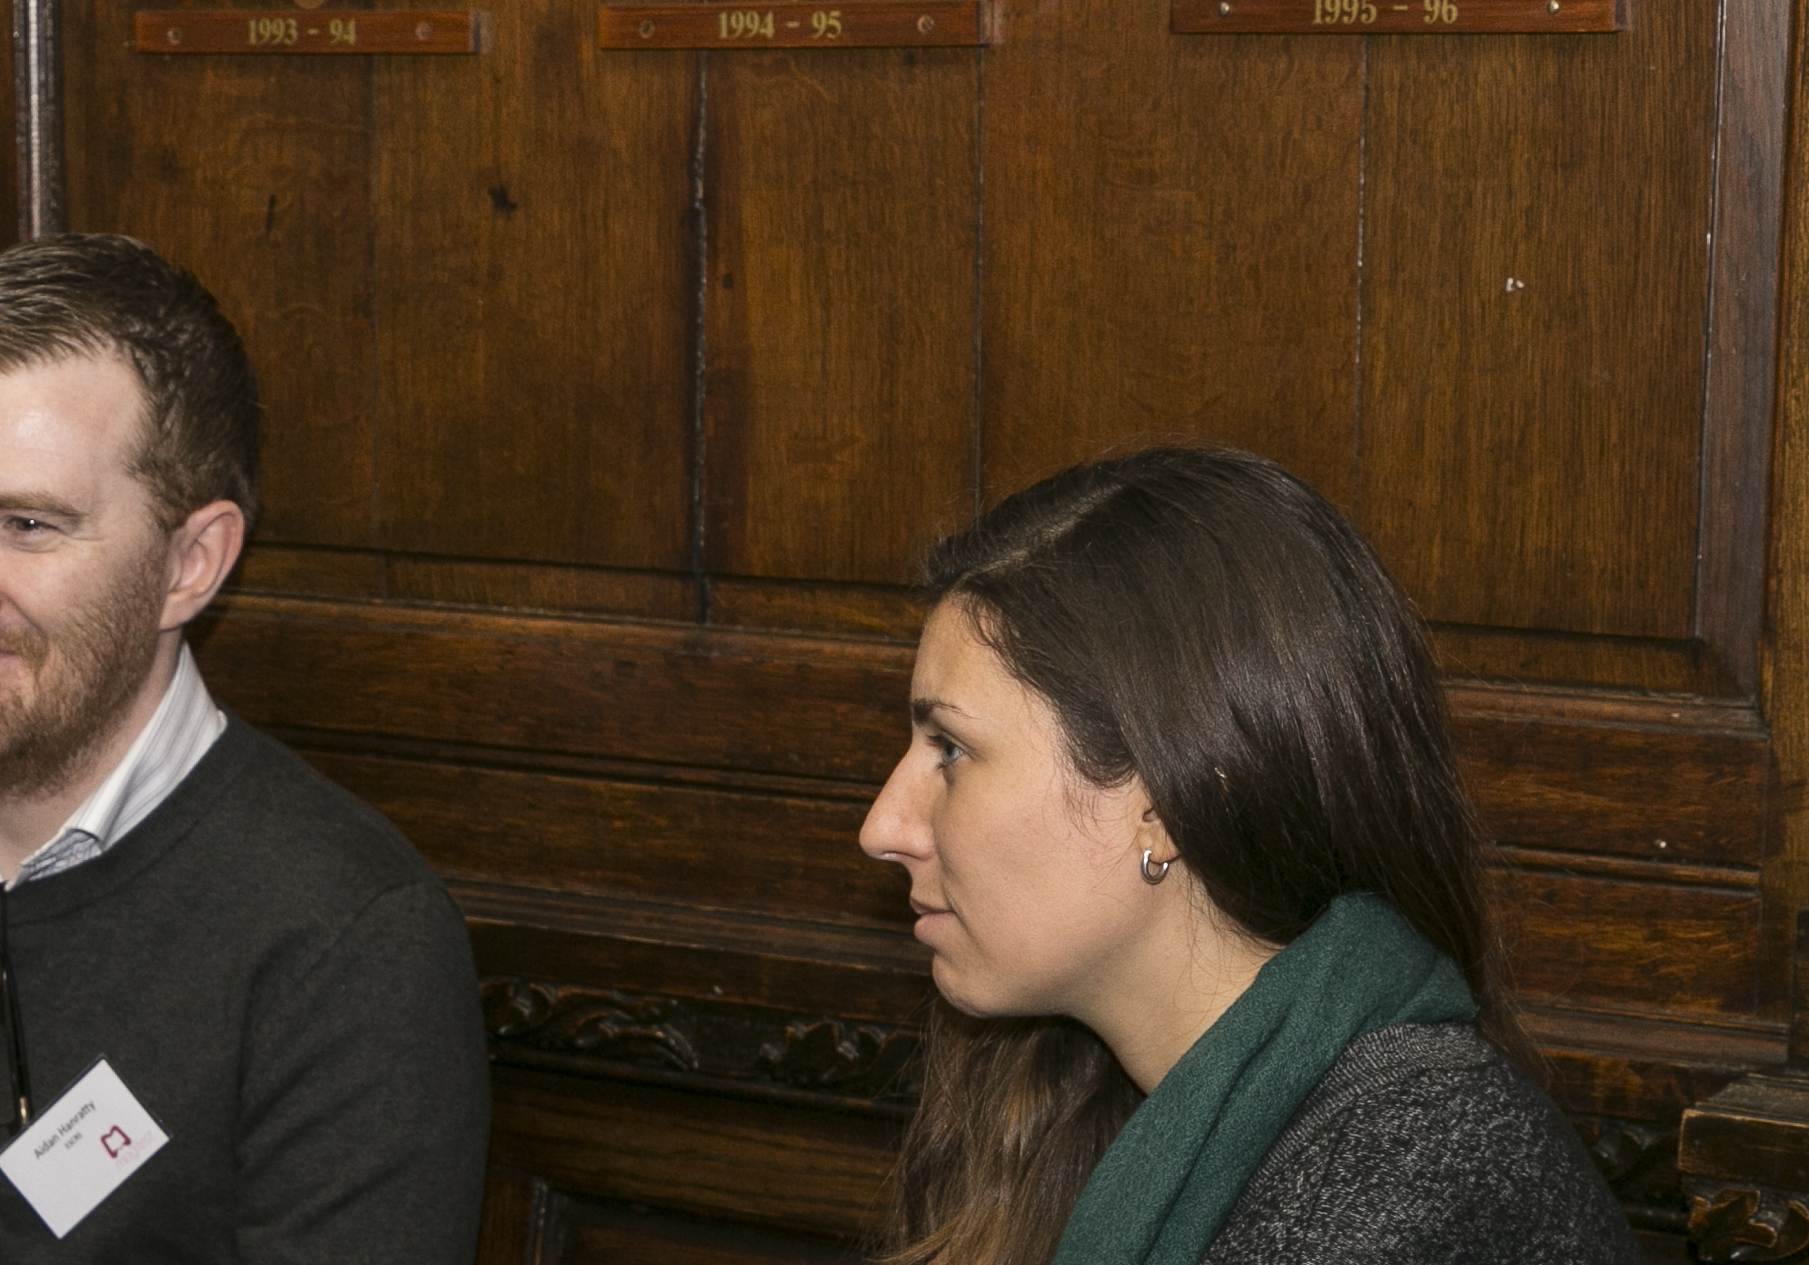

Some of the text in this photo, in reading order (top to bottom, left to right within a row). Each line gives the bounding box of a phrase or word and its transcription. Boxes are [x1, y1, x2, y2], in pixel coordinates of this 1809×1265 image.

[718, 10, 774, 39] 1994
[812, 10, 842, 39] 95
[1313, 0, 1378, 24] 1995
[1423, 0, 1458, 24] 96
[248, 17, 298, 45] 1993
[329, 17, 357, 45] 94
[34, 1100, 95, 1159] Aidan Hanratty
